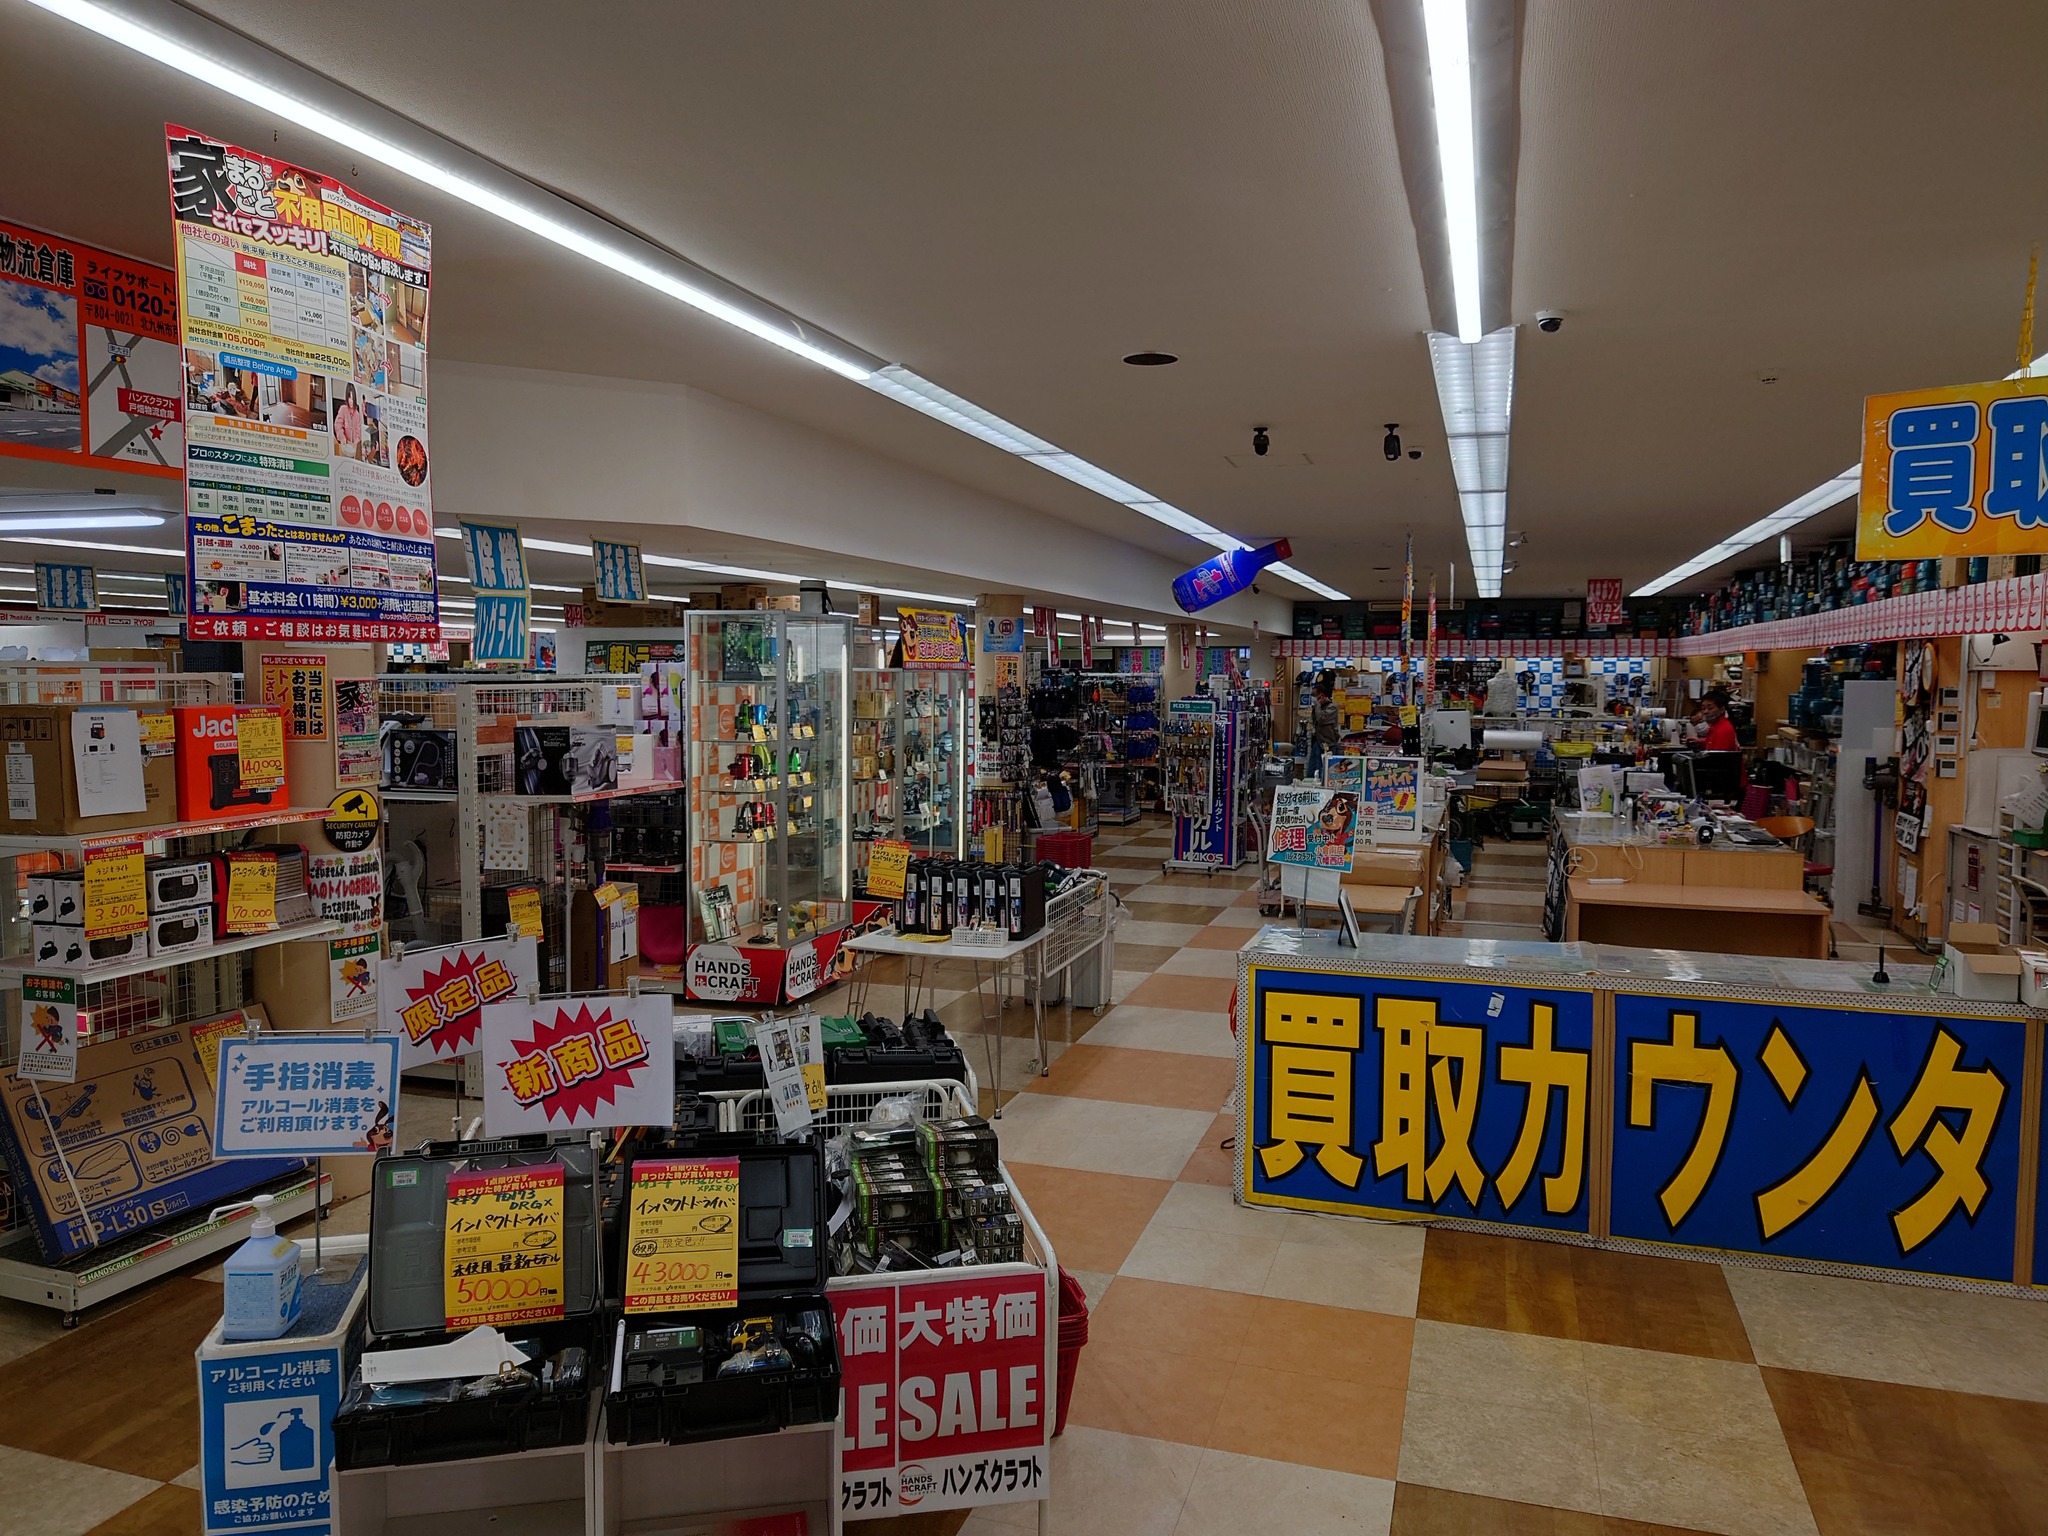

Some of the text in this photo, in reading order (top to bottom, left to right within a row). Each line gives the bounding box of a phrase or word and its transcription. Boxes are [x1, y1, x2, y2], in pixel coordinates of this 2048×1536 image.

[169, 137, 237, 216] 家
[180, 223, 239, 249] 他社との違い
[0, 231, 76, 290] 物流倉庫
[243, 259, 257, 271] 当社
[329, 241, 428, 286] 不用品のお悩み解決します!
[86, 259, 176, 297] ライフサポート
[238, 277, 265, 290] ¥150,000
[243, 294, 266, 306] ¥60,000
[269, 285, 295, 298] ¥200,000
[245, 316, 268, 328] ¥15,000
[304, 309, 323, 320] ¥5,000
[223, 354, 293, 376] 遺品整理 Before After
[128, 391, 175, 408] ハンズクラフト
[128, 402, 175, 420] 戸畑物流倉庫
[190, 447, 259, 464] プロのスタッフによる
[1883, 393, 2048, 538] 買取
[195, 513, 346, 543] その他、こまったことはありませんか?
[300, 545, 342, 555] エアコンメニュー
[87, 615, 106, 625] MAX
[1588, 613, 1620, 623] トリマー
[193, 619, 437, 640] ご依頼・ご相談はお気軽に店頭スタッフまで
[263, 657, 324, 665] 申し訳ございません
[291, 669, 307, 736] お客様用
[308, 669, 324, 736] 当店には
[192, 714, 238, 738] Jac
[1367, 772, 1414, 789] アルバイト
[1276, 791, 1319, 805] 処分する前に
[1371, 787, 1398, 802] パート
[1275, 814, 1306, 824] お見積りから!
[1276, 806, 1300, 815] 是非一度
[326, 821, 376, 830] SECURITY CAMERAS
[88, 836, 136, 848] HANDSCRAFT
[335, 830, 370, 840] 防犯カメラ
[1272, 826, 1307, 851] 修理
[1307, 834, 1335, 843] 受付中!
[344, 840, 363, 848] 作動中
[1285, 852, 1315, 861] ハンズクラフト
[1315, 855, 1345, 866] 八幡西店
[344, 946, 370, 956] お客様へ
[695, 961, 751, 976] HANDS
[789, 953, 817, 975] HANDS
[26, 978, 71, 990] お子様連れの
[707, 976, 760, 991] CRAFT
[795, 964, 821, 987] CRAFT
[35, 990, 62, 999] お客様へ
[402, 959, 514, 1042] 限定品
[710, 989, 758, 999] ハンズクラフト
[505, 1018, 646, 1100] 新商品
[243, 1061, 376, 1092] 手指消毒
[241, 1097, 376, 1116] アルコール消毒を
[240, 1115, 370, 1134] ご利用頂けます。
[1258, 990, 2010, 1257] 買取カウンタ
[148, 1143, 157, 1153] 3
[57, 1171, 67, 1182] 2
[484, 1174, 532, 1186] 1点限りです。
[640, 1170, 734, 1181] 見つけた時が買い時です!
[457, 1178, 558, 1197] 見つけた時が買い時です!
[152, 1203, 166, 1217] S
[450, 1211, 560, 1233] インパクトドライバ
[178, 1221, 222, 1244] HANDSCRAFT
[512, 1241, 520, 1249] 円
[86, 1257, 136, 1282] HANDSCRAFT
[632, 1261, 723, 1284] 43,000 円
[631, 1291, 731, 1306] この商品をお売りください!
[453, 1307, 557, 1327] この商品をお売りください!
[899, 1291, 1038, 1351] 大特価
[834, 1305, 888, 1357] 価
[209, 1359, 332, 1384] アルコール消毒
[227, 1376, 316, 1394] ご利用ください
[899, 1364, 1038, 1443] SALE
[901, 1475, 933, 1485] HANDS
[941, 1455, 1043, 1496] ハンズクラフト
[908, 1482, 938, 1493] CRAFT
[213, 1489, 330, 1516] 感染予防のため
[233, 1508, 315, 1525] ご協力お願いします
